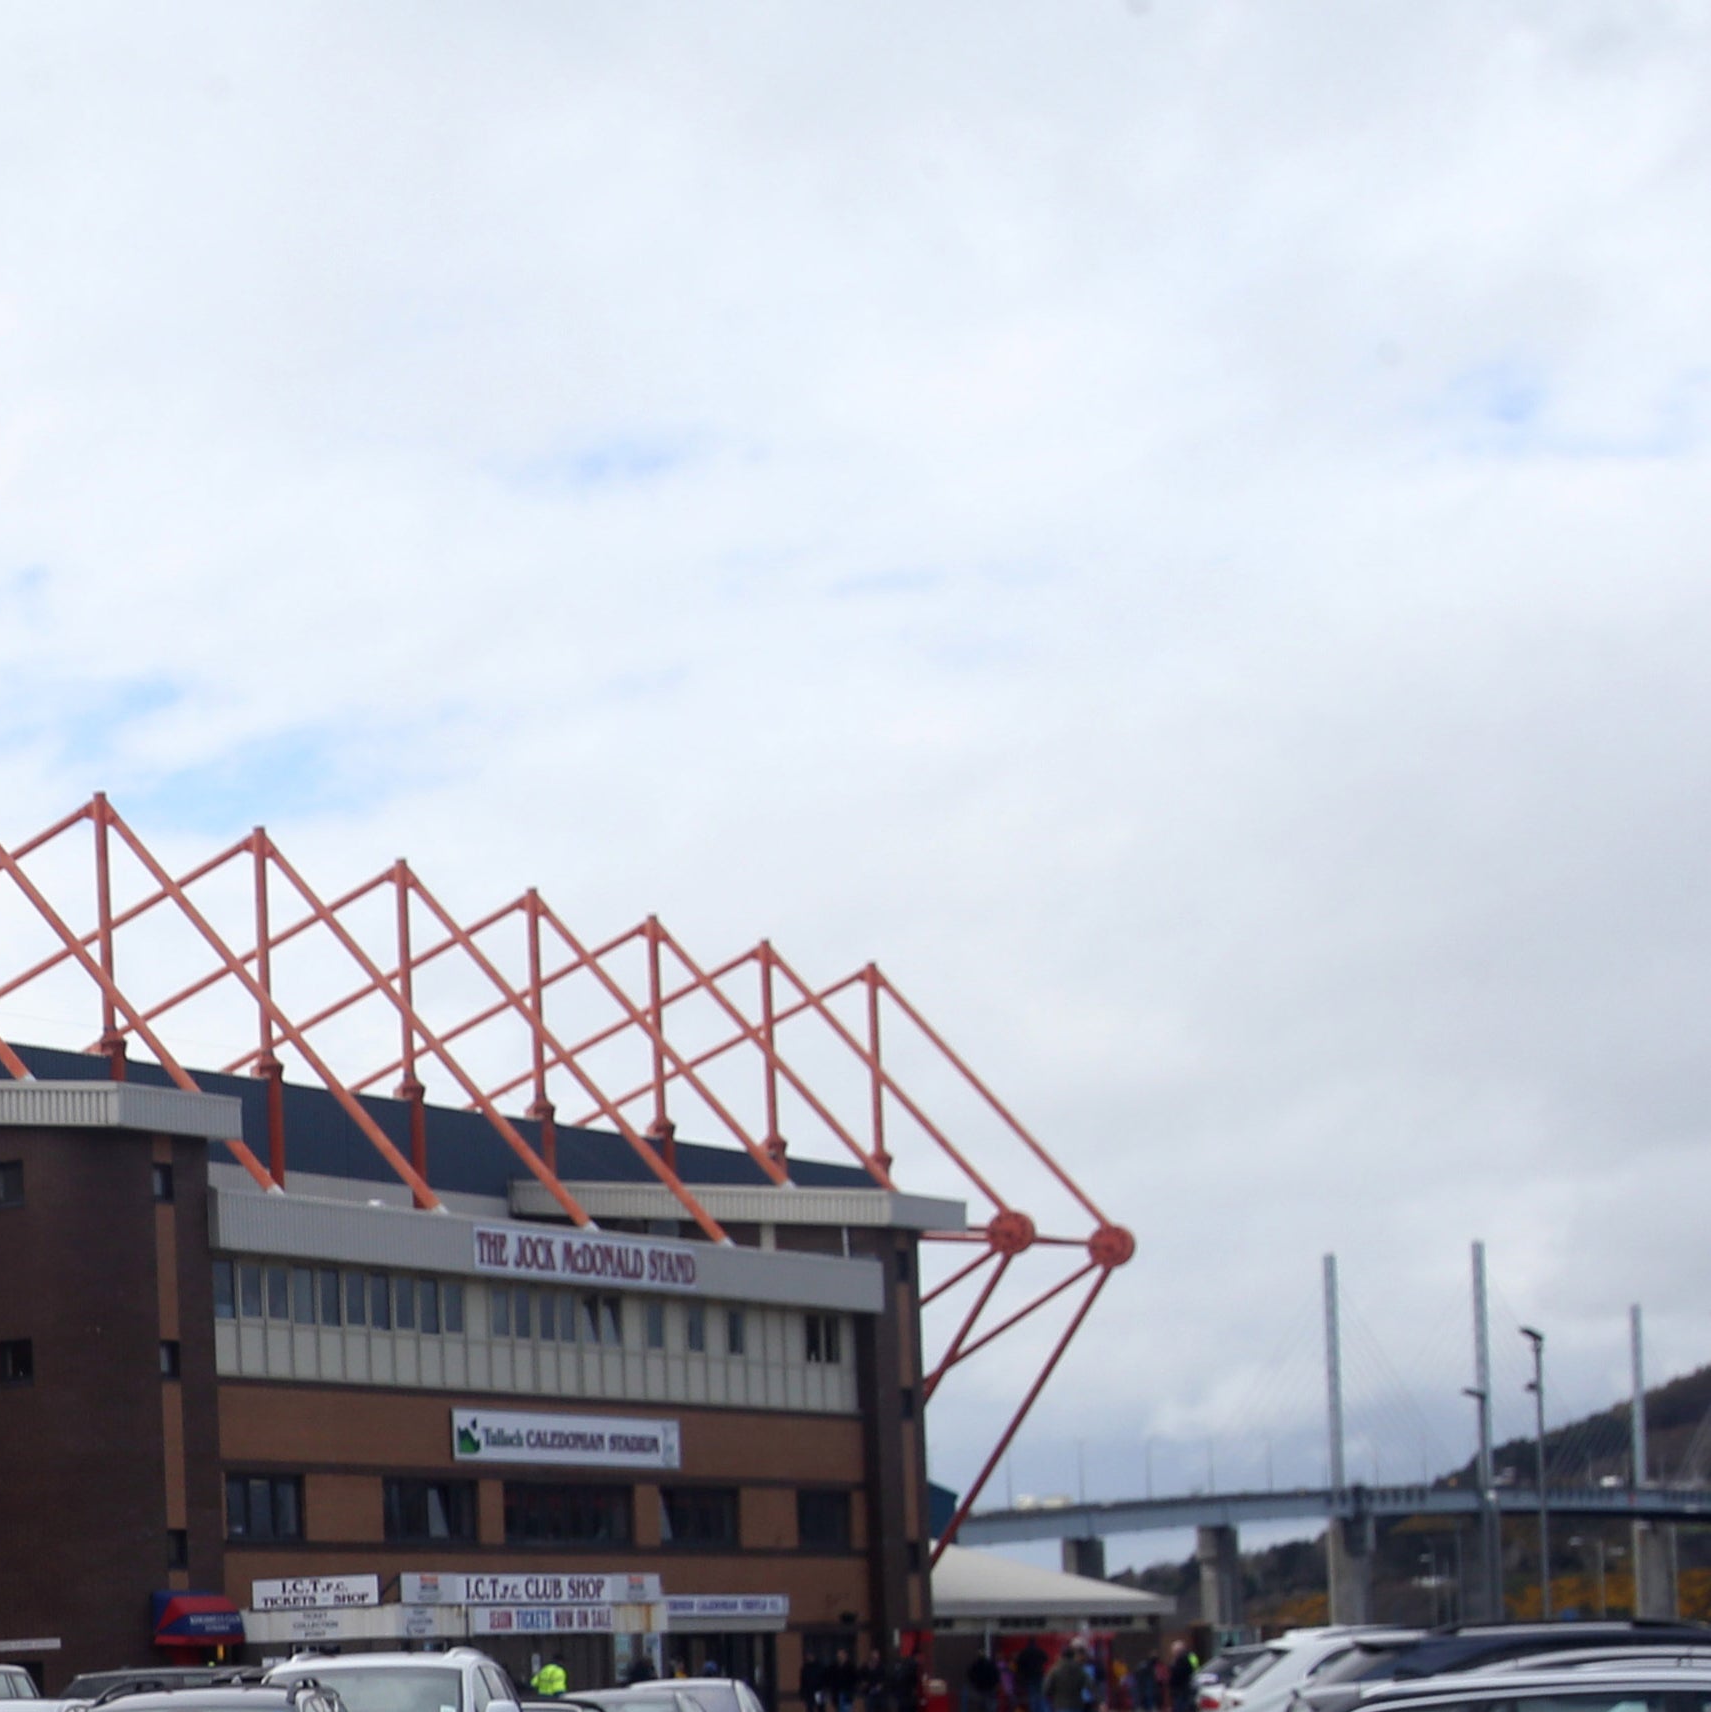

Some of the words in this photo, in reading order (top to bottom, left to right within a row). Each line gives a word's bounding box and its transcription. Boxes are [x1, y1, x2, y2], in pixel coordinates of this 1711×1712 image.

[477, 1232, 508, 1266] THE
[515, 1236, 556, 1271] JOCK
[648, 1248, 696, 1285] STAND
[526, 1429, 605, 1450] CALEDONIAN
[608, 1433, 660, 1453] STADIUM
[525, 1578, 563, 1599] CLUB
[567, 1577, 605, 1599] SHOP
[262, 1596, 317, 1608] TICKETS
[333, 1593, 370, 1605] SHOP
[516, 1610, 552, 1629] TICKETS
[554, 1609, 574, 1628] NOW
[577, 1609, 588, 1628] ON
[591, 1608, 612, 1628] SALE
